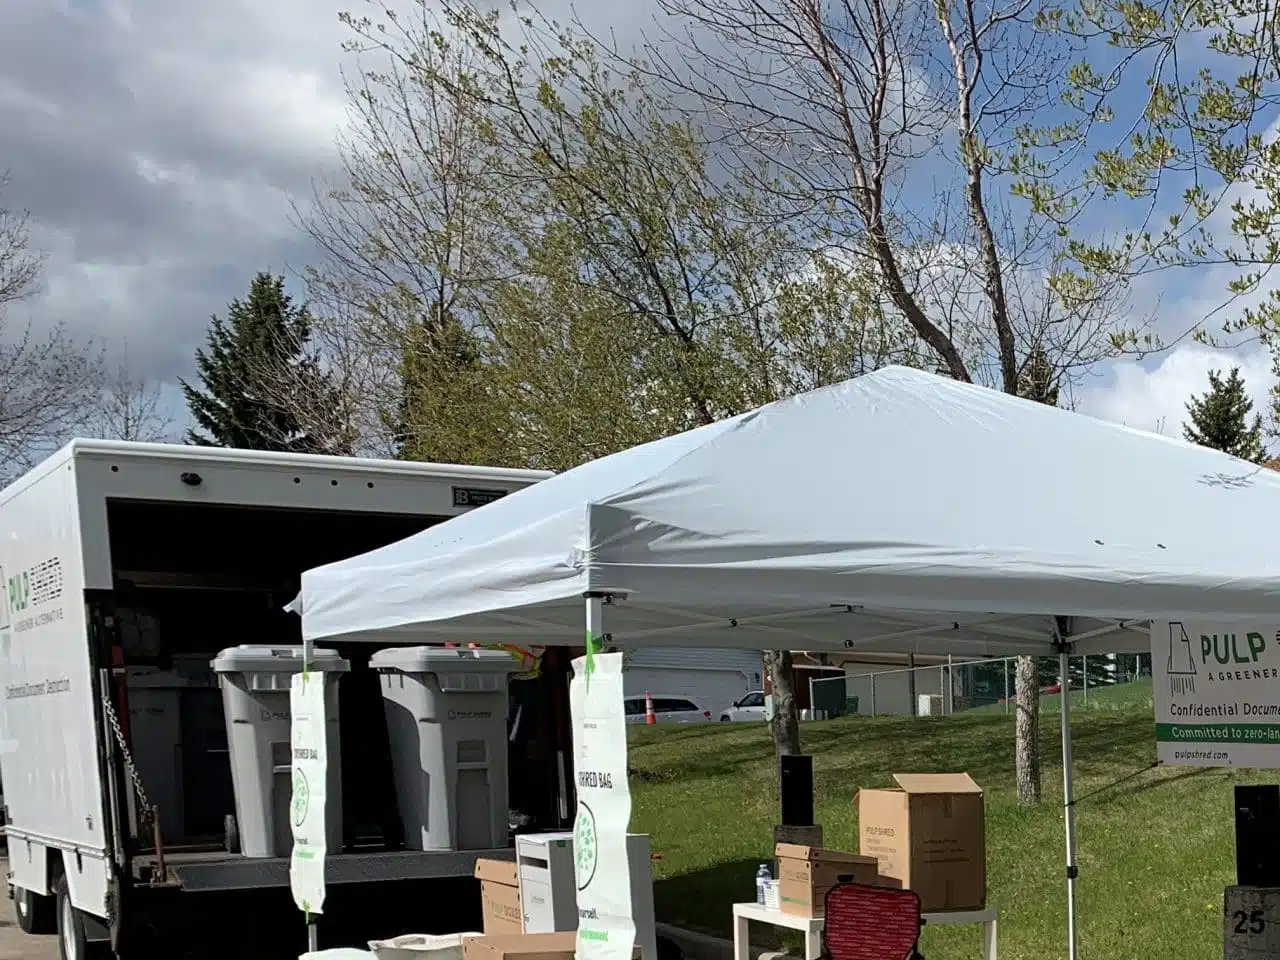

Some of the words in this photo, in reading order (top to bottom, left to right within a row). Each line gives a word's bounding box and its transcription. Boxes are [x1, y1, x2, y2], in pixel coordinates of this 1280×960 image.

[8, 571, 28, 613] PULP
[1200, 632, 1266, 665] PULP
[1208, 672, 1214, 681] A
[1219, 668, 1278, 681] GREENER
[1170, 703, 1239, 717] Confidential
[1172, 726, 1229, 739] Committed
[1231, 728, 1242, 739] to
[1174, 749, 1229, 760] pulpshred.com
[598, 772, 613, 789] BAG
[1233, 910, 1265, 934] 25
